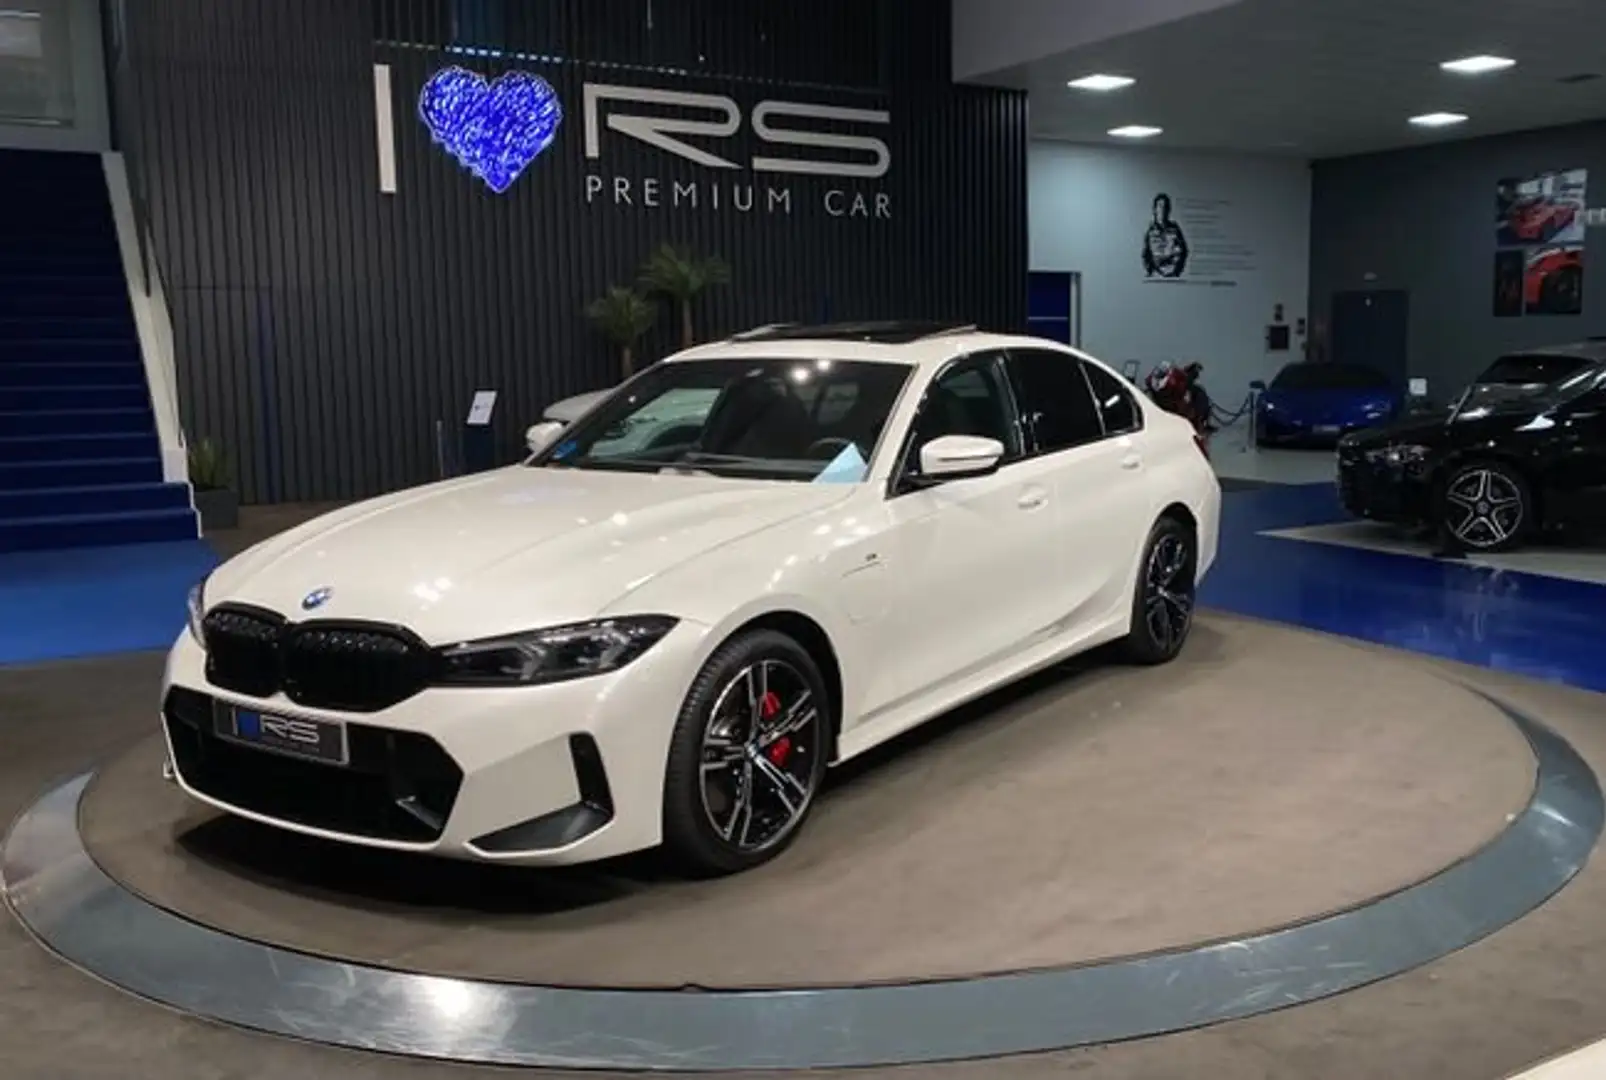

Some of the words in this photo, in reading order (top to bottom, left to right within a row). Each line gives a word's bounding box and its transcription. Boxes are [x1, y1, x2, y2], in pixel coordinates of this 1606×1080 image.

[374, 64, 396, 193] I
[583, 83, 890, 178] RS
[586, 175, 791, 213] PREMIUM
[824, 190, 891, 218] CAR
[260, 714, 320, 743] RS
